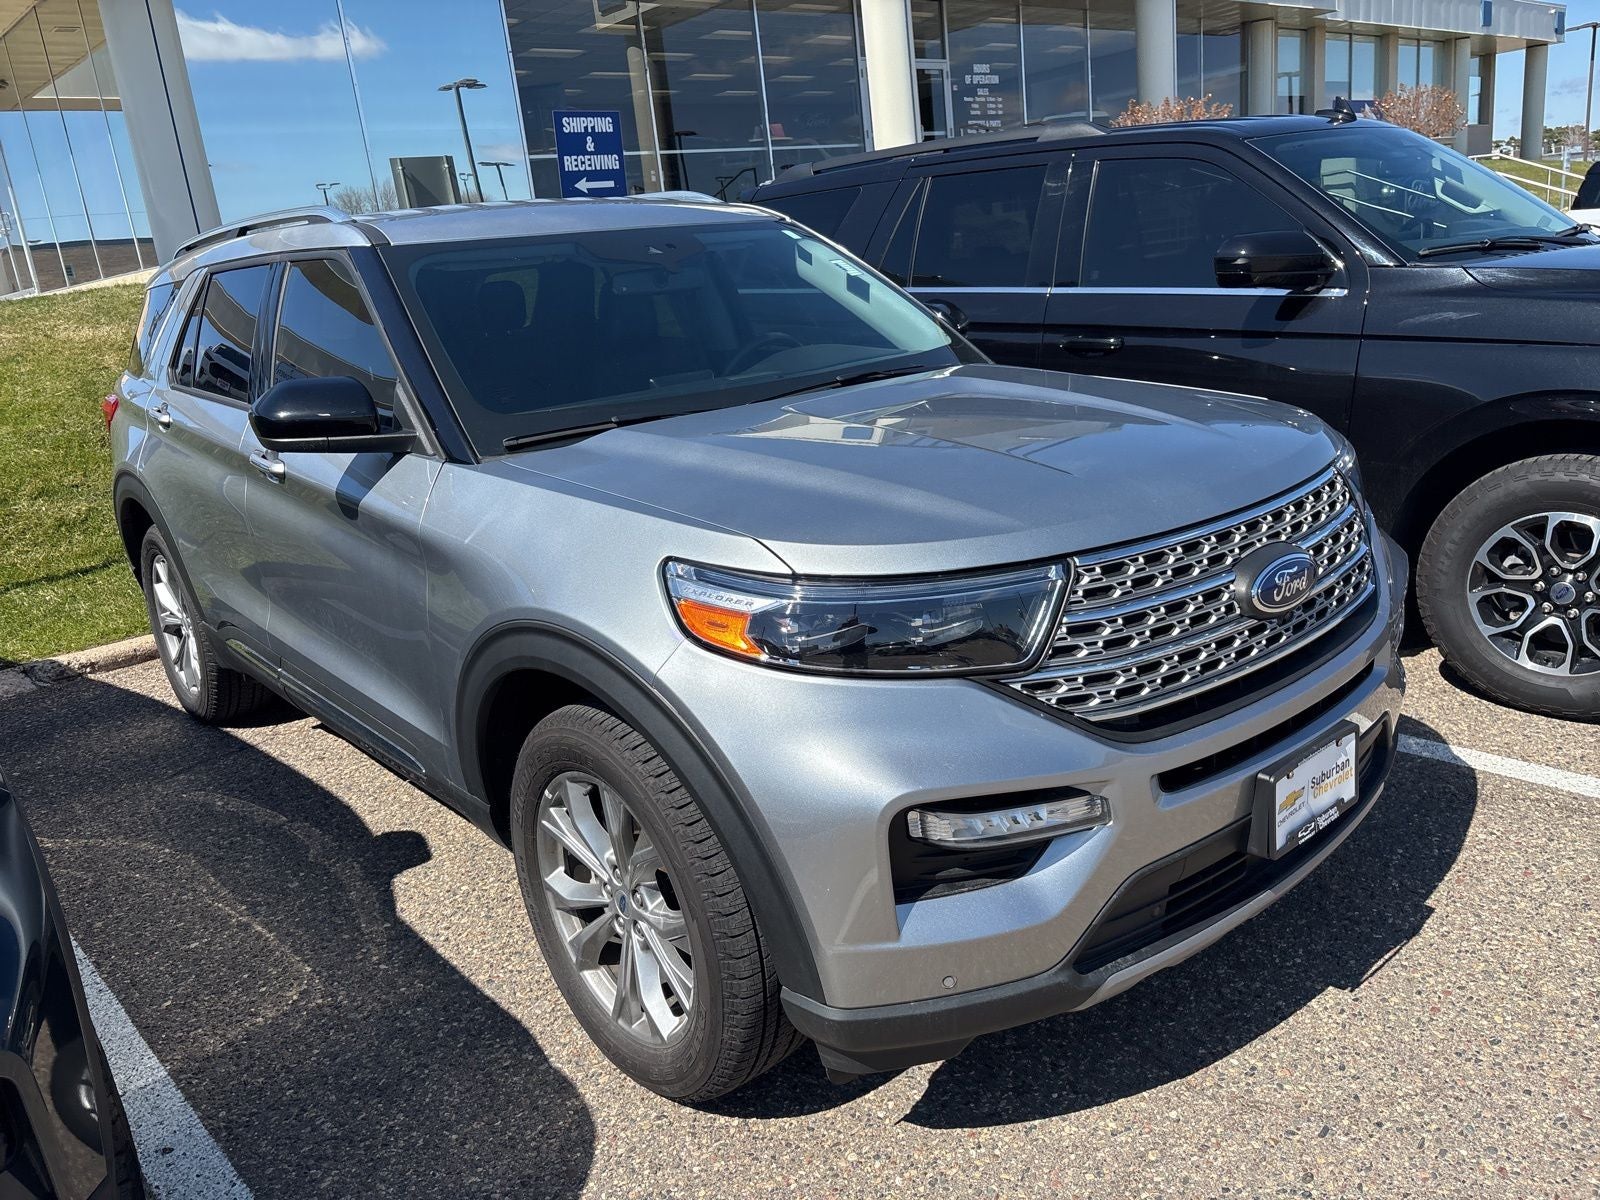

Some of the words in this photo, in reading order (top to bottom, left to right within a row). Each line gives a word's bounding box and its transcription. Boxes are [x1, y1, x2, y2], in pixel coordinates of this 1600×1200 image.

[562, 116, 614, 133] SHIPPING
[586, 135, 595, 151] &
[563, 154, 620, 171] RECEIVING
[1273, 565, 1308, 602] Ford
[1310, 758, 1350, 789] Suburban
[1313, 766, 1353, 799] Chevrolet
[1277, 801, 1306, 828] CHEVROLET
